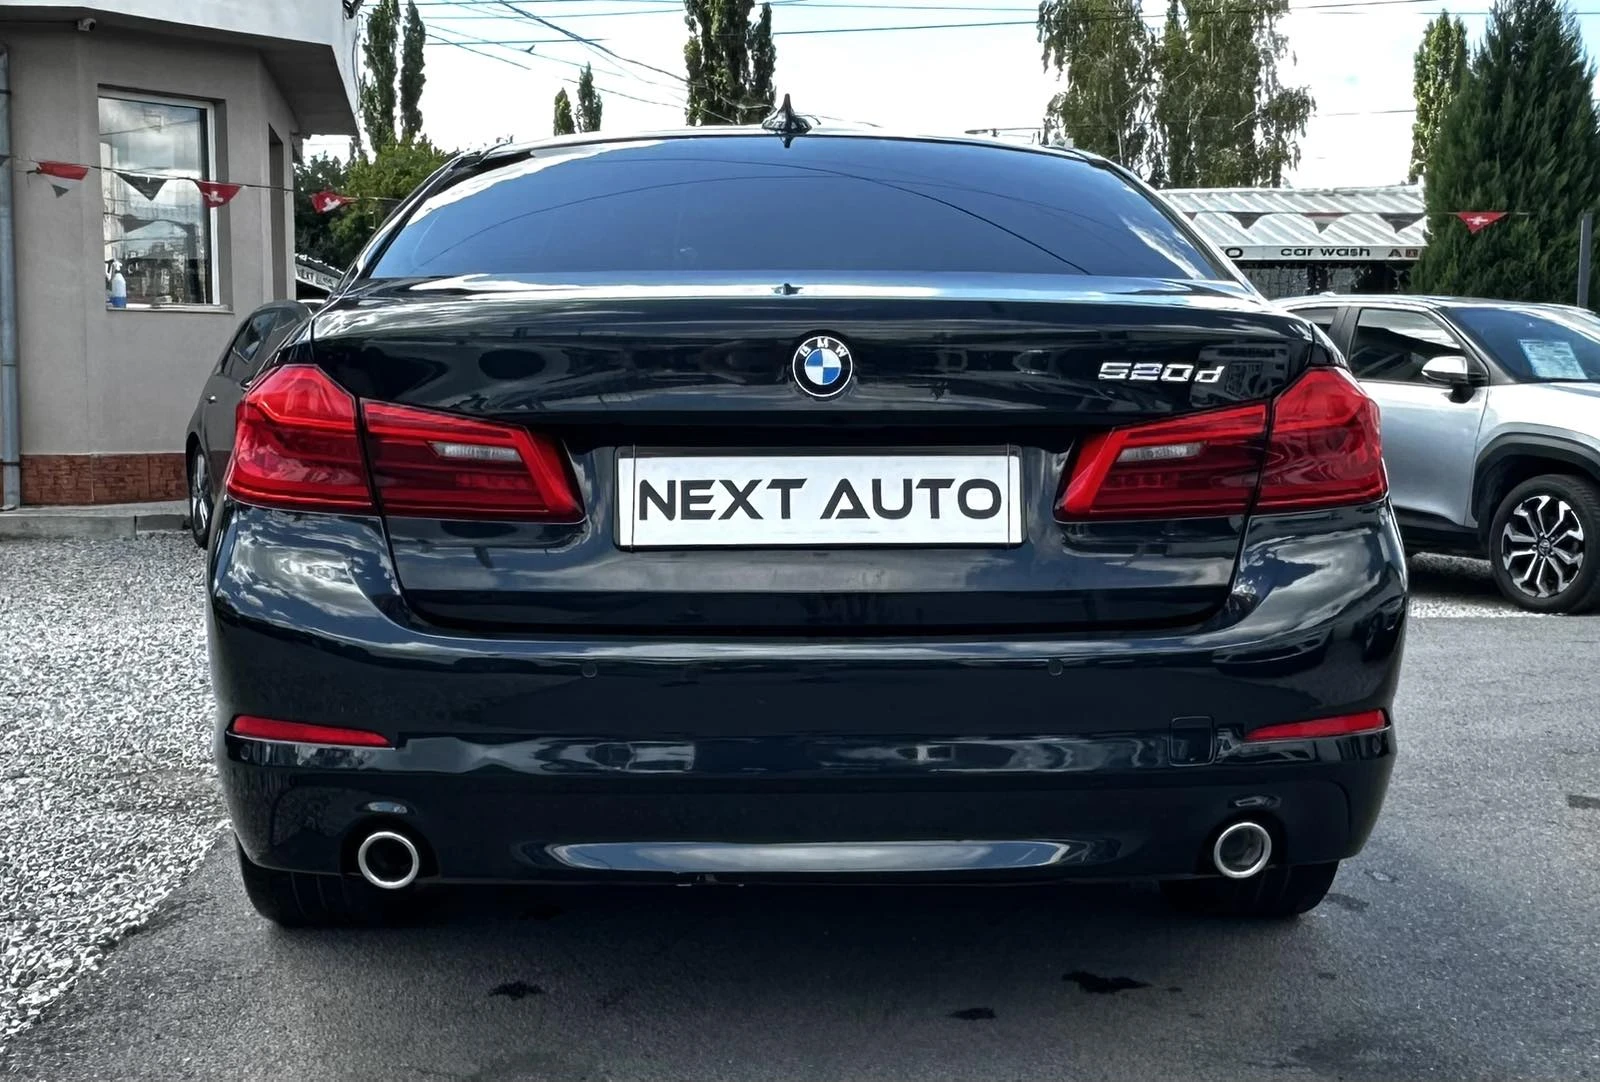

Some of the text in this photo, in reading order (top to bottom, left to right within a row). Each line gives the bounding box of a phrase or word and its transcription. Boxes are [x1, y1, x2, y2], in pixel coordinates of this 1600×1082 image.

[1281, 248, 1370, 257] car wash
[799, 337, 848, 358] BMW
[1098, 362, 1225, 383] 520d
[639, 478, 1002, 521] NEXT AUTO
